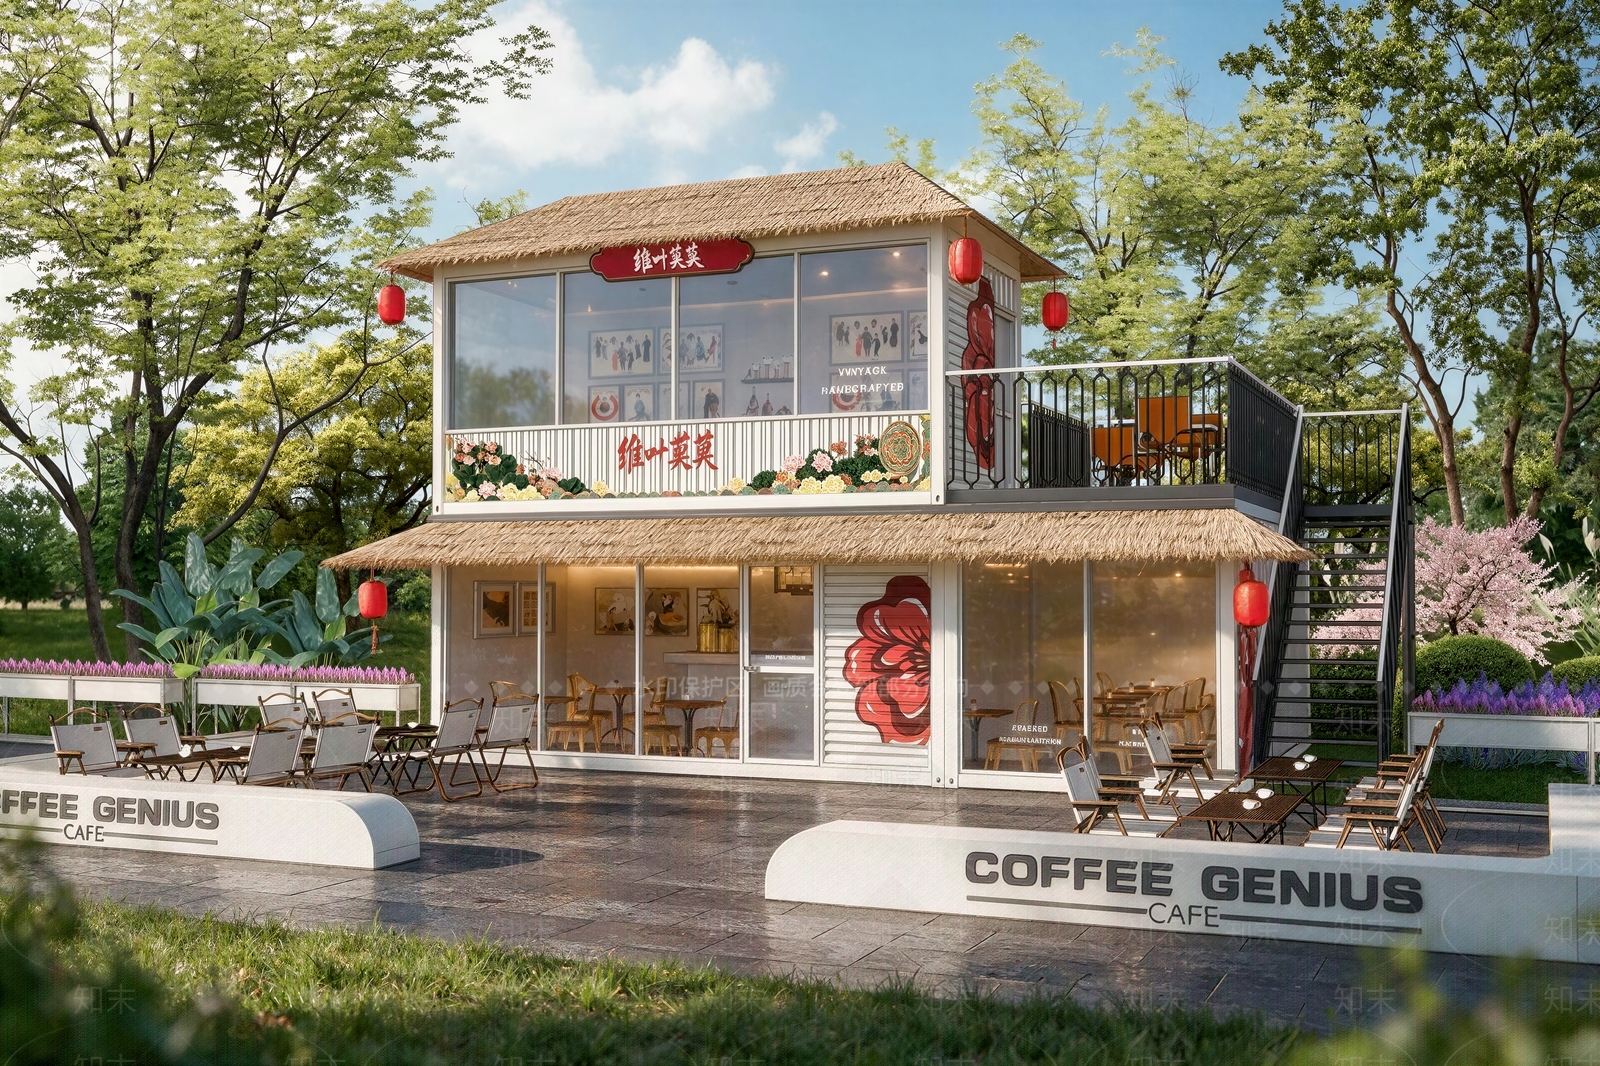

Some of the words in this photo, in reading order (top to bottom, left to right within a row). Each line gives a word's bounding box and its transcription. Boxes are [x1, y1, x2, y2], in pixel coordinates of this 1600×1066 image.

[0, 789, 79, 820] FFEE
[93, 795, 220, 830] GENIUS
[63, 823, 105, 842] CAFE
[965, 851, 1174, 897] COFFEE
[1201, 865, 1423, 914] GENIUS
[1148, 902, 1220, 928] CAFE
